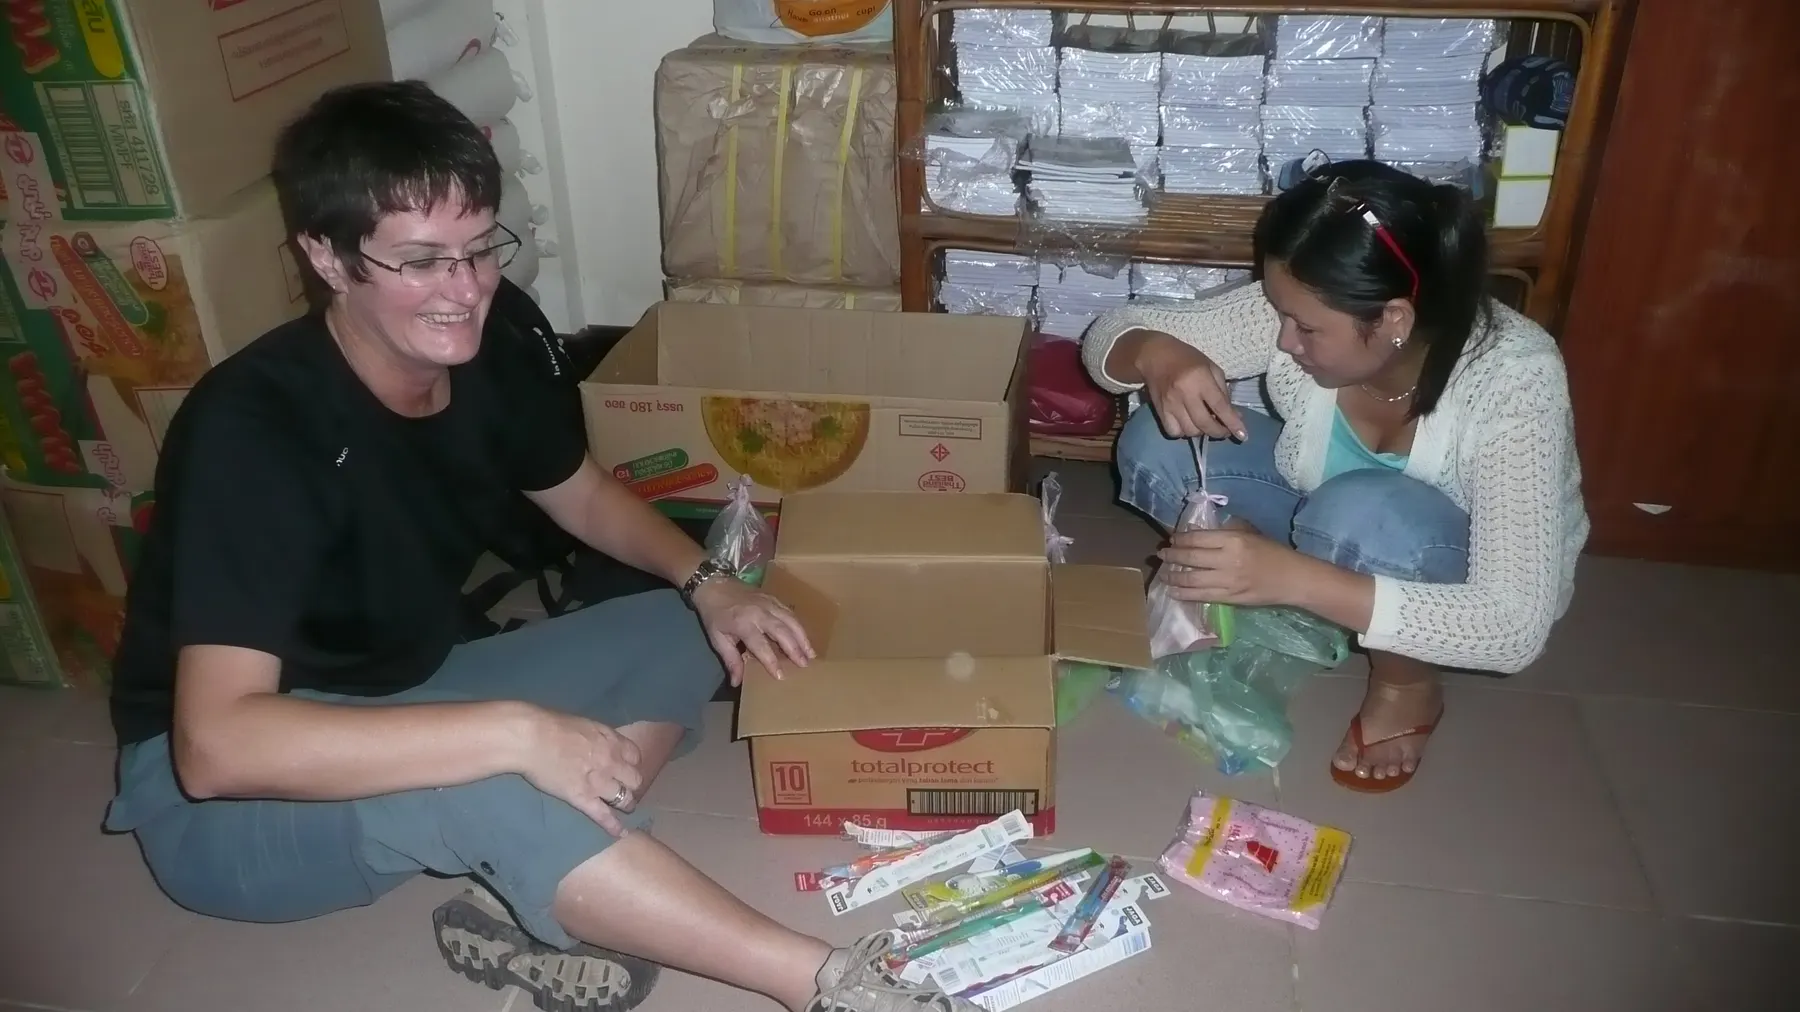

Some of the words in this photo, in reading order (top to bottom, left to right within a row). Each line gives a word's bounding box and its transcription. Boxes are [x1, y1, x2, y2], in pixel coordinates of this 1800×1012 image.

[823, 7, 837, 15] on
[129, 135, 161, 195] 411728
[629, 401, 653, 413] 180
[923, 480, 961, 489] Thailand
[851, 758, 995, 777] totalprotect
[776, 765, 805, 791] 10
[803, 814, 833, 827] 144
[852, 814, 871, 827] 85
